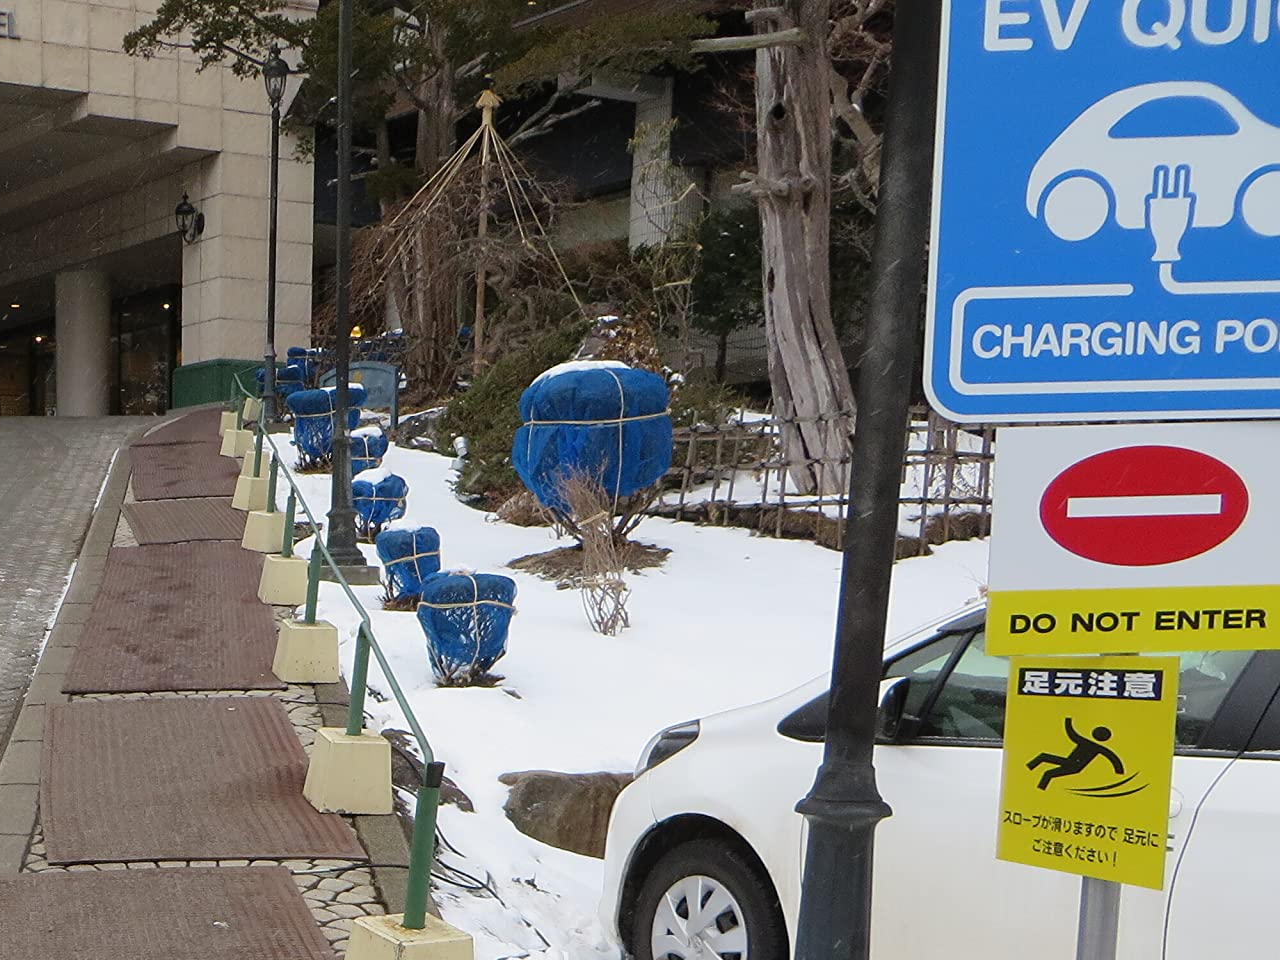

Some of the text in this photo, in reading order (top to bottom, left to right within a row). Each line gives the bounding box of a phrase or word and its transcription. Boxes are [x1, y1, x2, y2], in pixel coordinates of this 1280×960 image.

[984, 0, 1280, 52] EV QUI
[972, 318, 1280, 359] CHARGING PO
[1009, 608, 1267, 634] DO NOT ENTER
[1022, 670, 1156, 698] 足元注意
[1003, 810, 1160, 848] スロープが滑りますので 足元に
